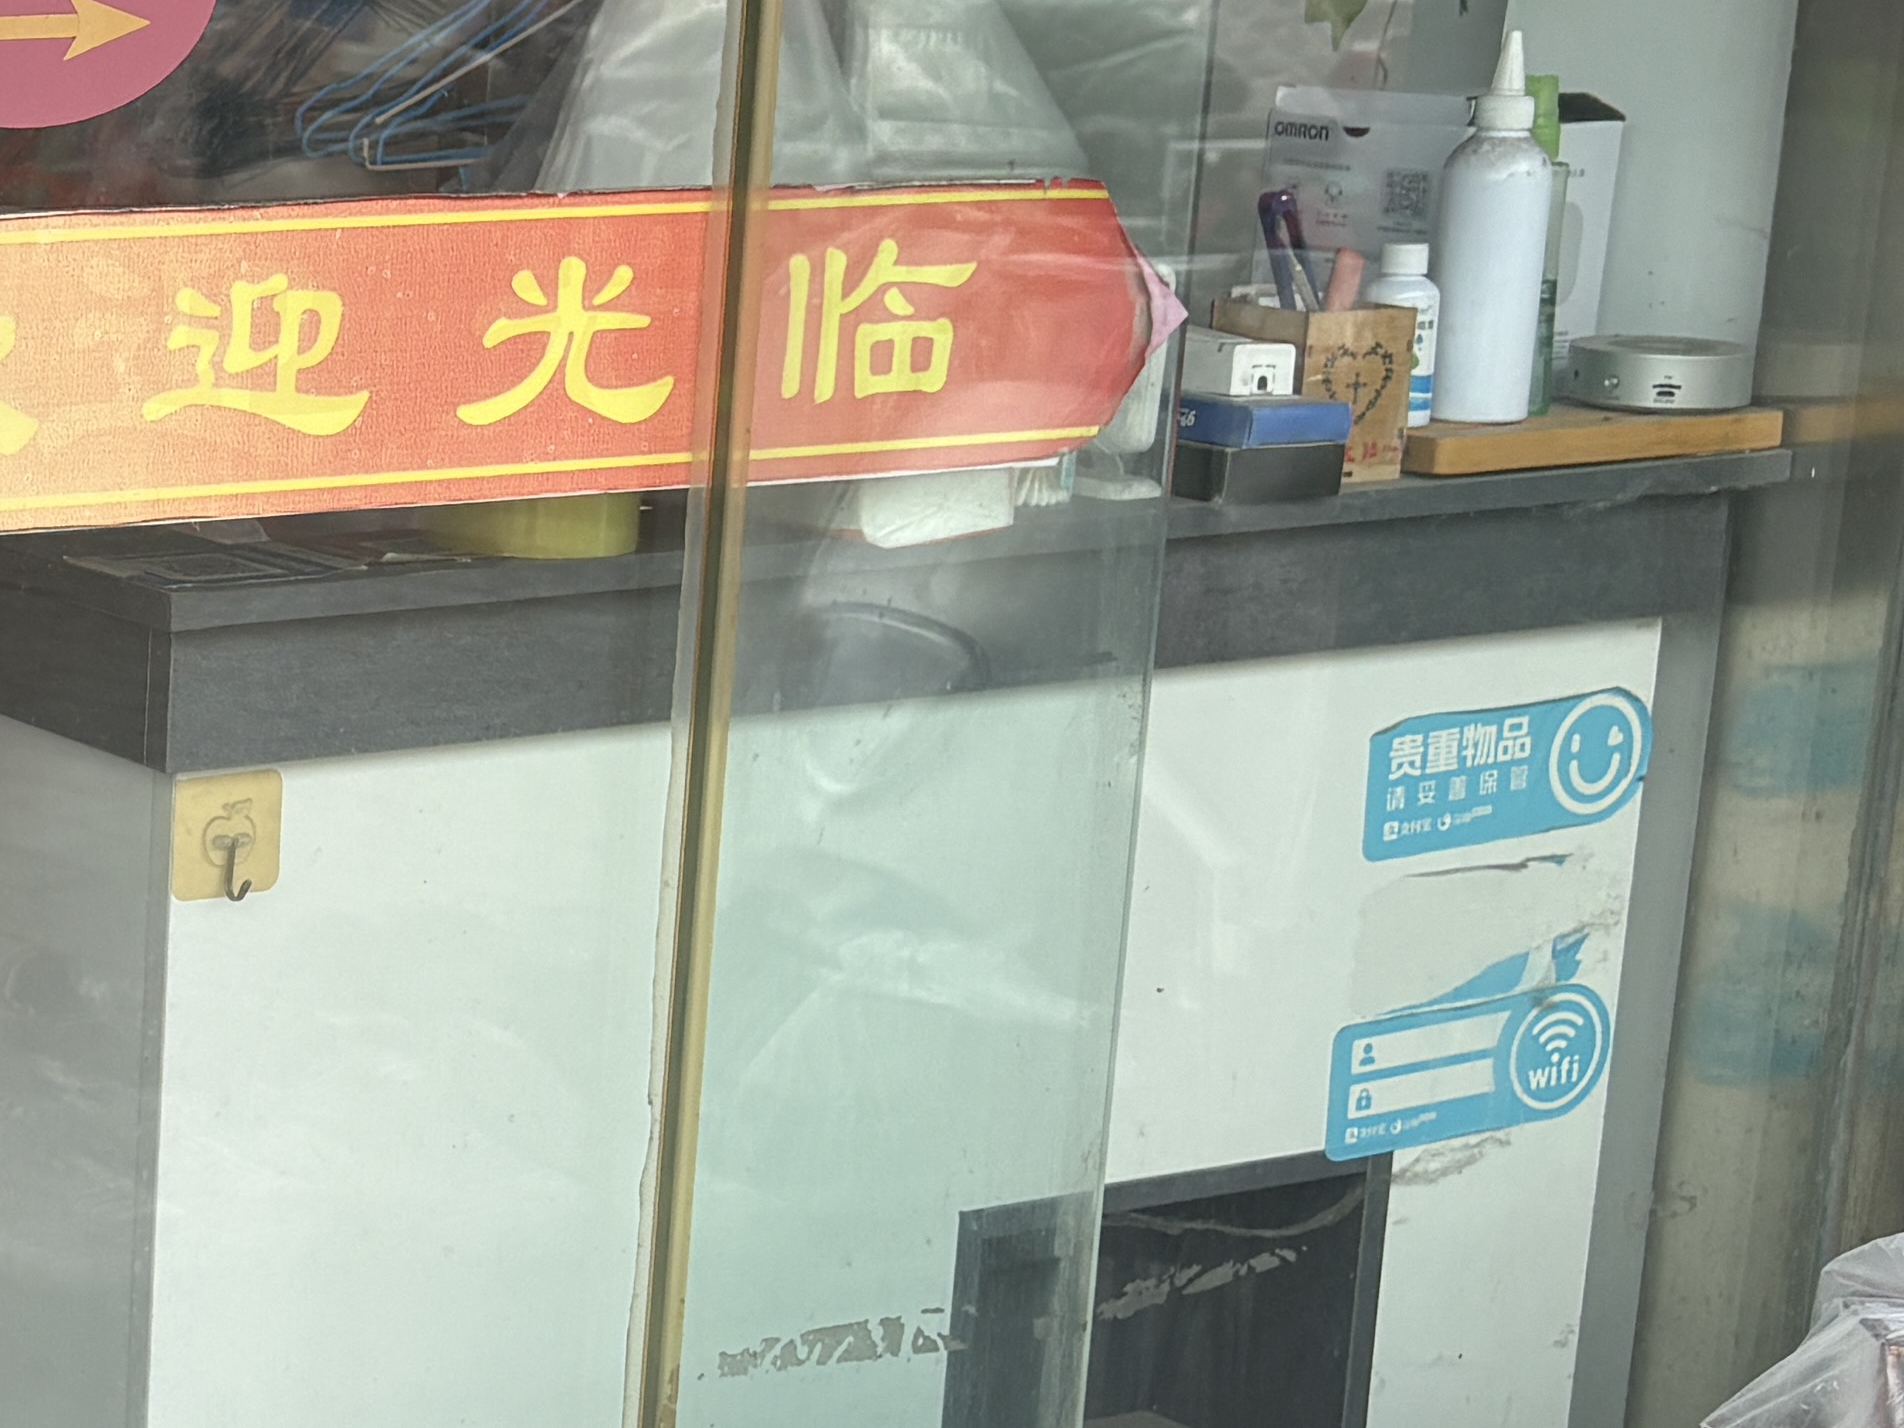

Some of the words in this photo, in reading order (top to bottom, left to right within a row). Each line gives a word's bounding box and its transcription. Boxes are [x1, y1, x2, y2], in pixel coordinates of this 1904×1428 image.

[1389, 715, 1531, 781] 贵重物品
[1528, 1051, 1580, 1091] wifi
